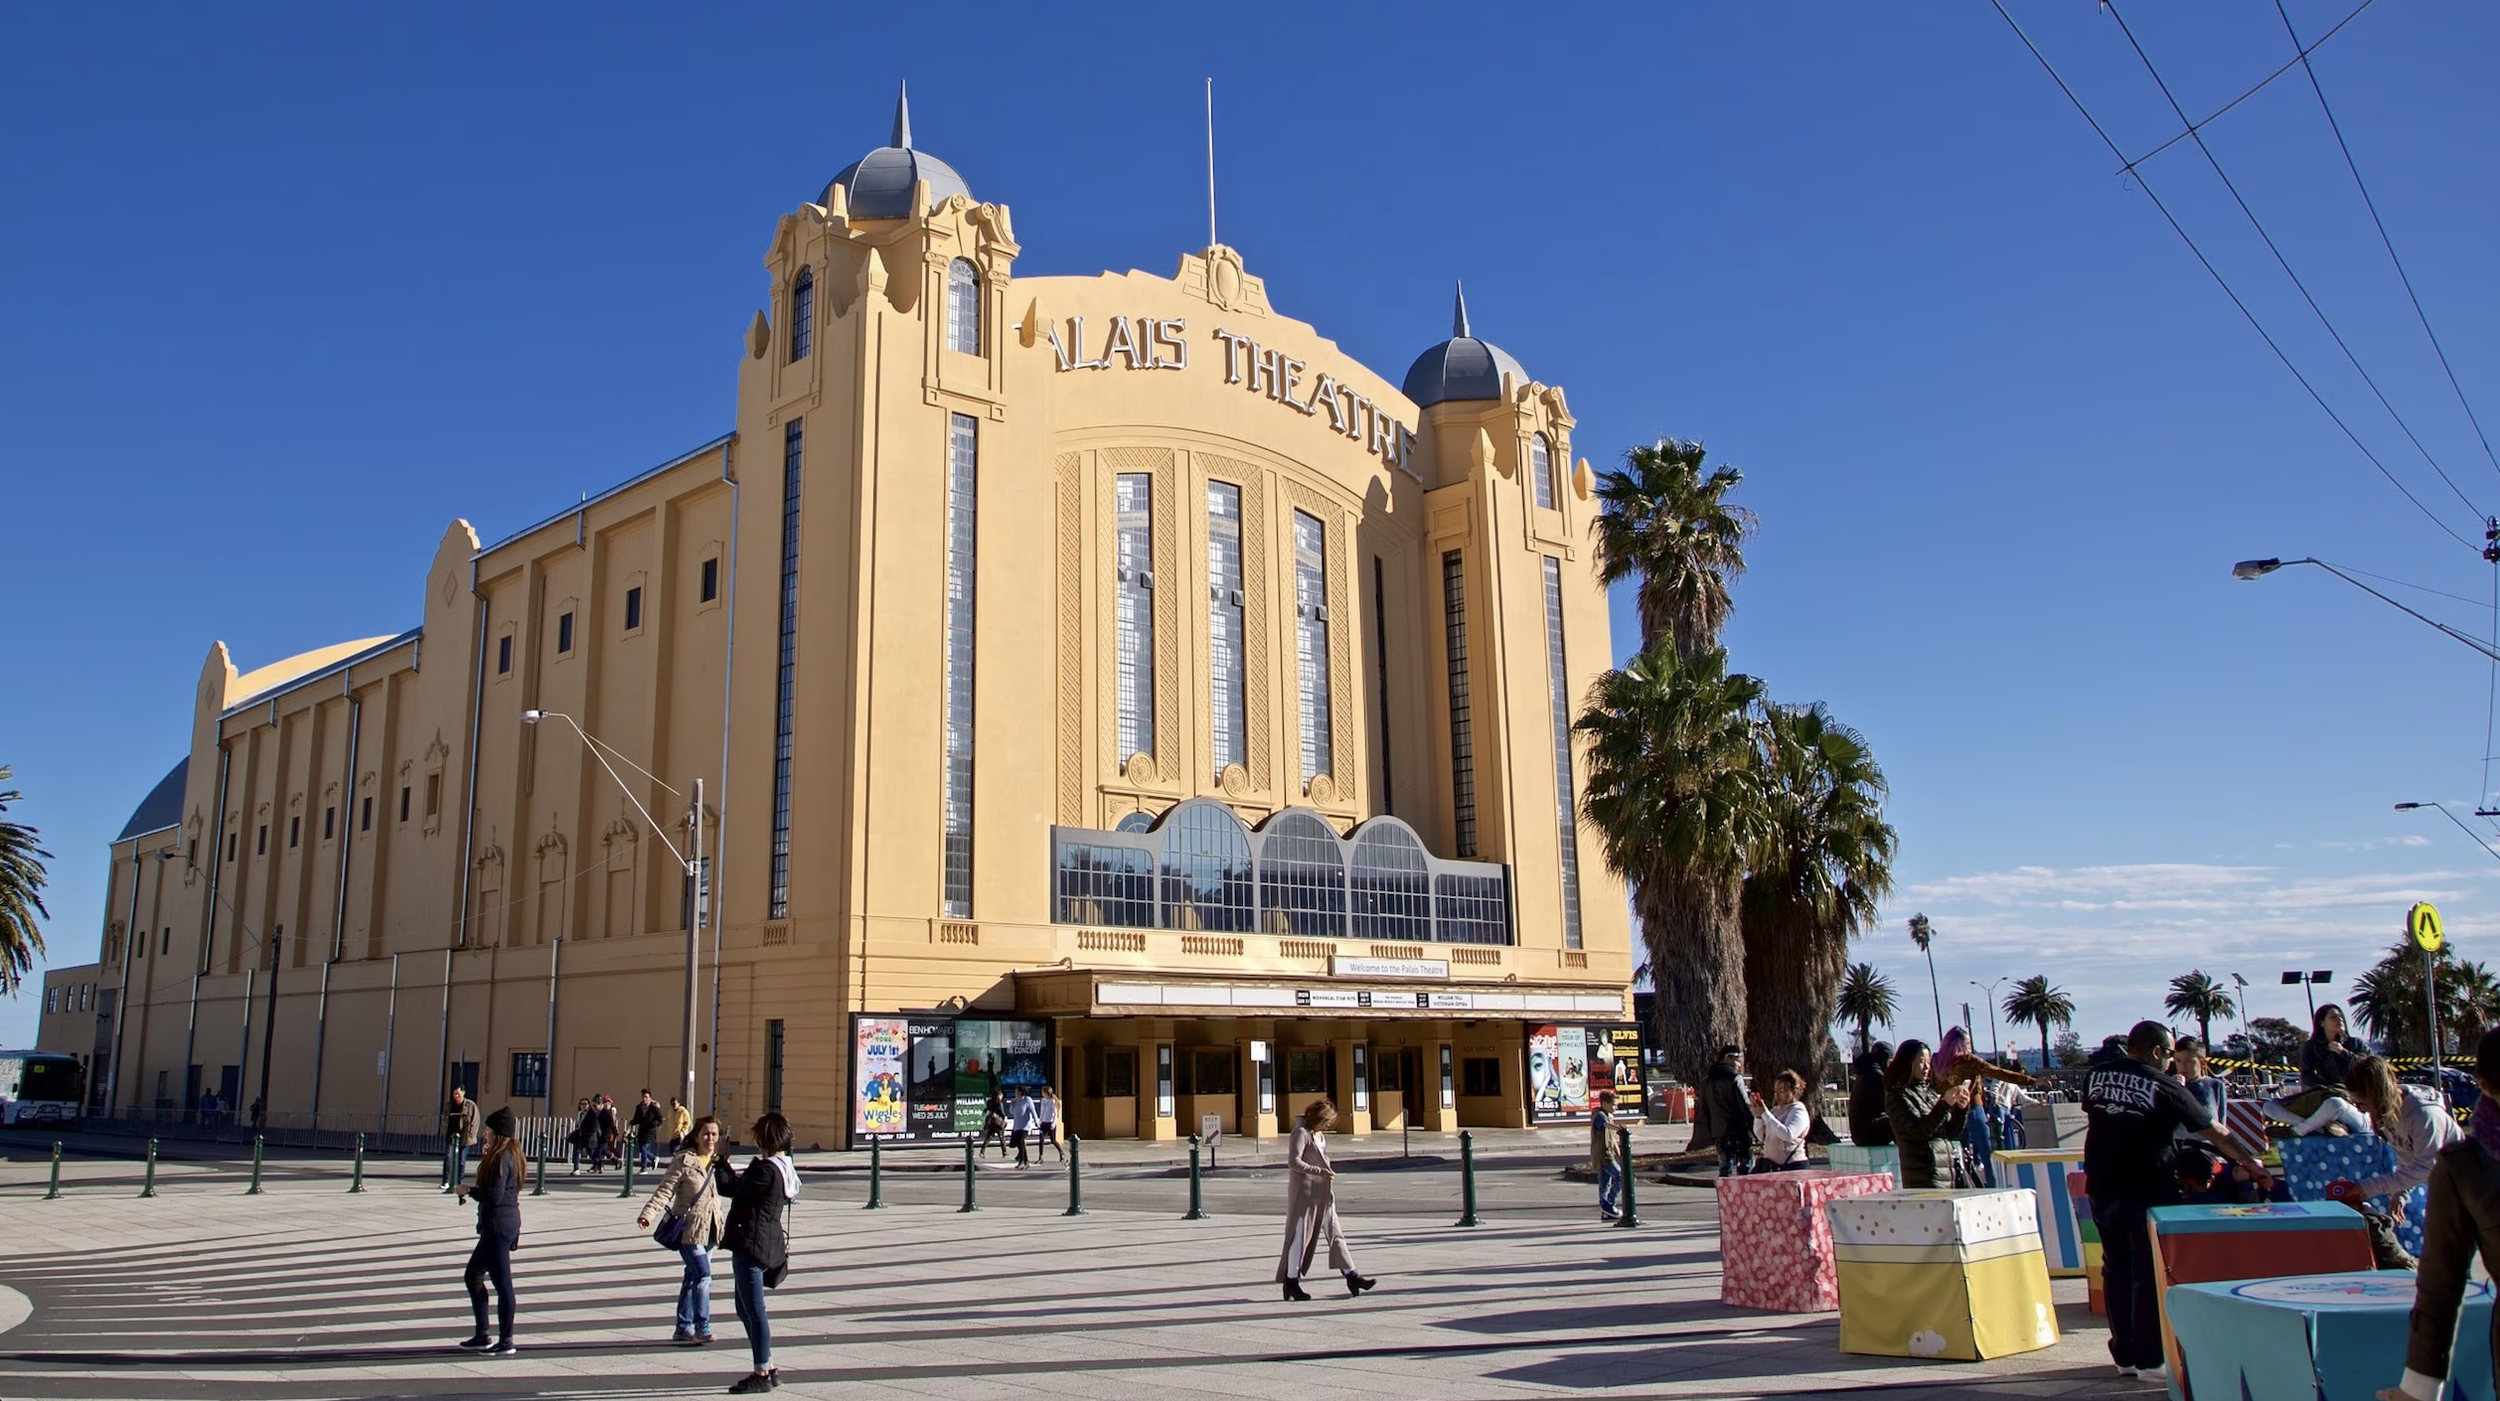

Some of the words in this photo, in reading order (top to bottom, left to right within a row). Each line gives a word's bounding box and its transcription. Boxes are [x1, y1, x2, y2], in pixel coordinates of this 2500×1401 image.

[1012, 316, 1188, 373] ALAIS
[1350, 963, 1380, 972] Welcome
[1381, 965, 1389, 973] to
[1389, 965, 1400, 973] the
[1402, 965, 1419, 974] Palais
[1420, 965, 1444, 975] Theatre
[909, 1025, 923, 1035] BEN
[923, 1025, 954, 1035] HOWARD
[1612, 1030, 1638, 1040] ELVIS
[1017, 1032, 1031, 1040] 2018
[867, 1045, 887, 1055] JULY
[888, 1045, 899, 1055] 1st
[1014, 1046, 1041, 1054] CONCERT
[956, 1097, 985, 1106] WILLIAM
[863, 1104, 903, 1123] Wiggles
